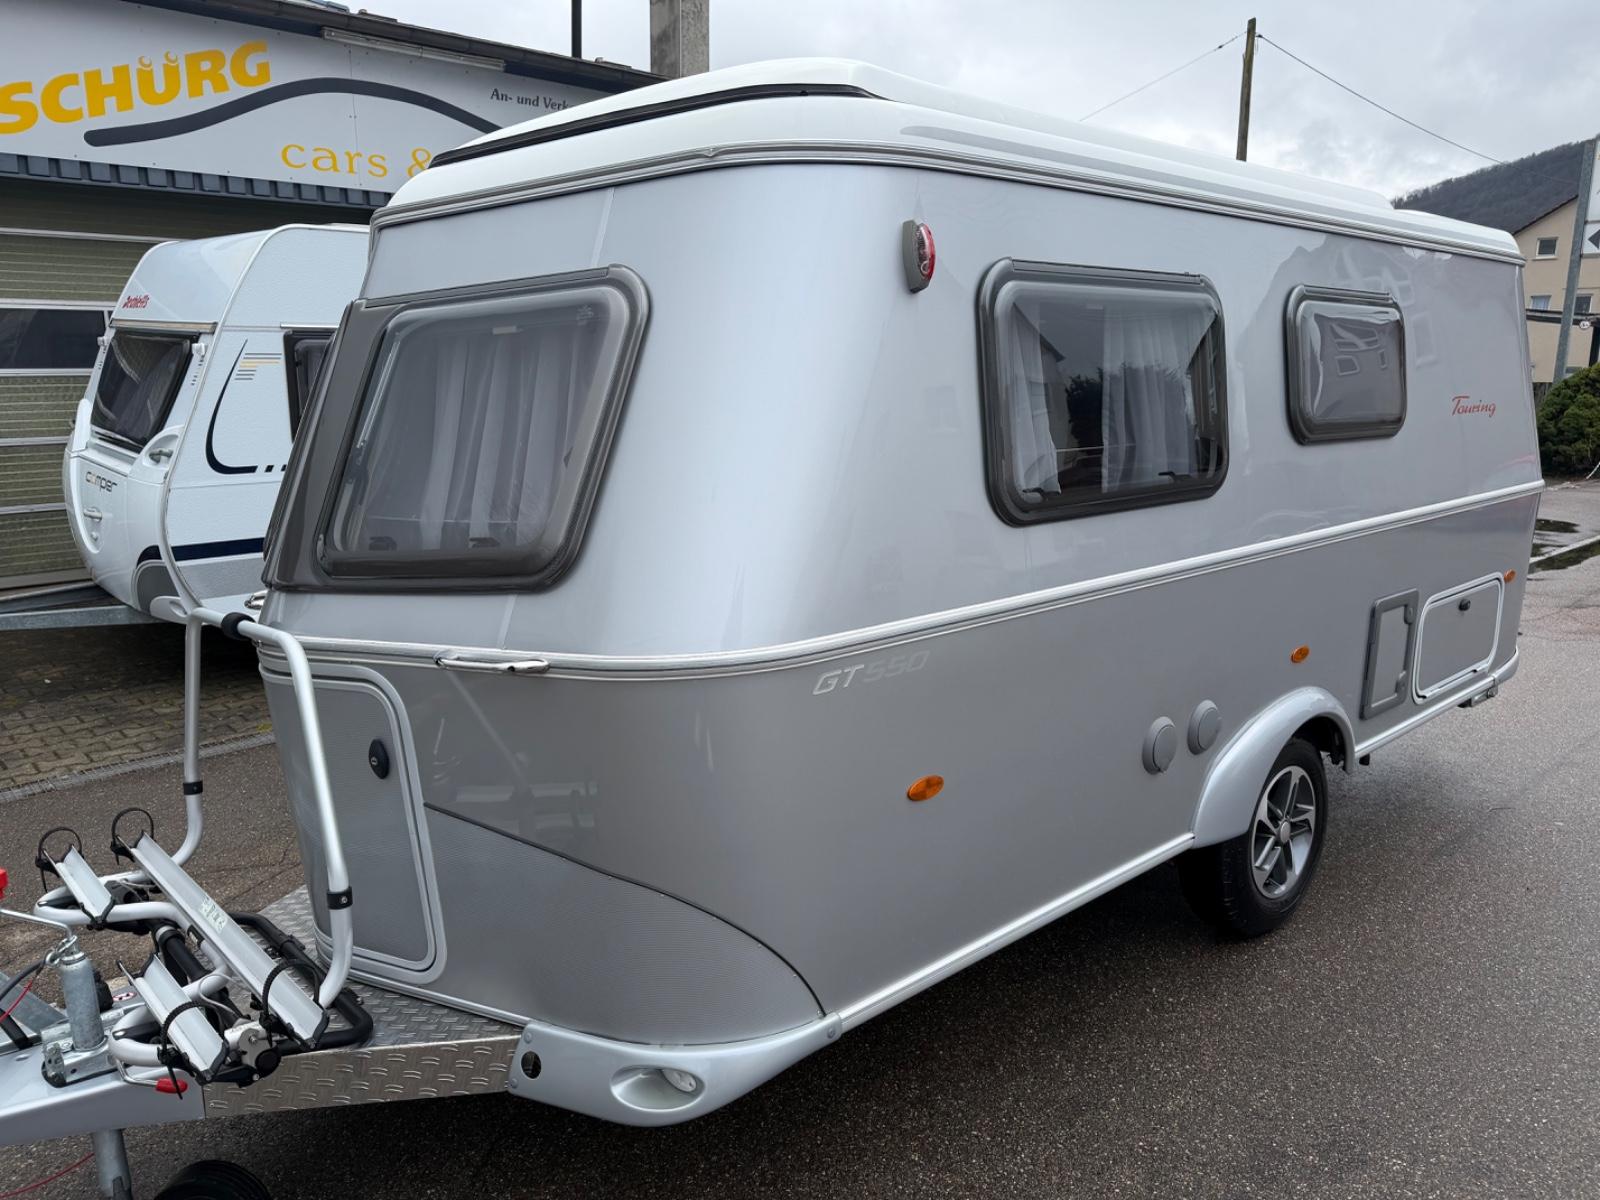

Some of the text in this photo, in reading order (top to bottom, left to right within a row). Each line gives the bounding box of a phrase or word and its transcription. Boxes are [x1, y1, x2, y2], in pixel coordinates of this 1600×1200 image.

[0, 39, 271, 135] SCHÜRG
[490, 88, 569, 111] An- und Verk
[280, 143, 431, 178] cars &
[1452, 395, 1496, 418] Touring
